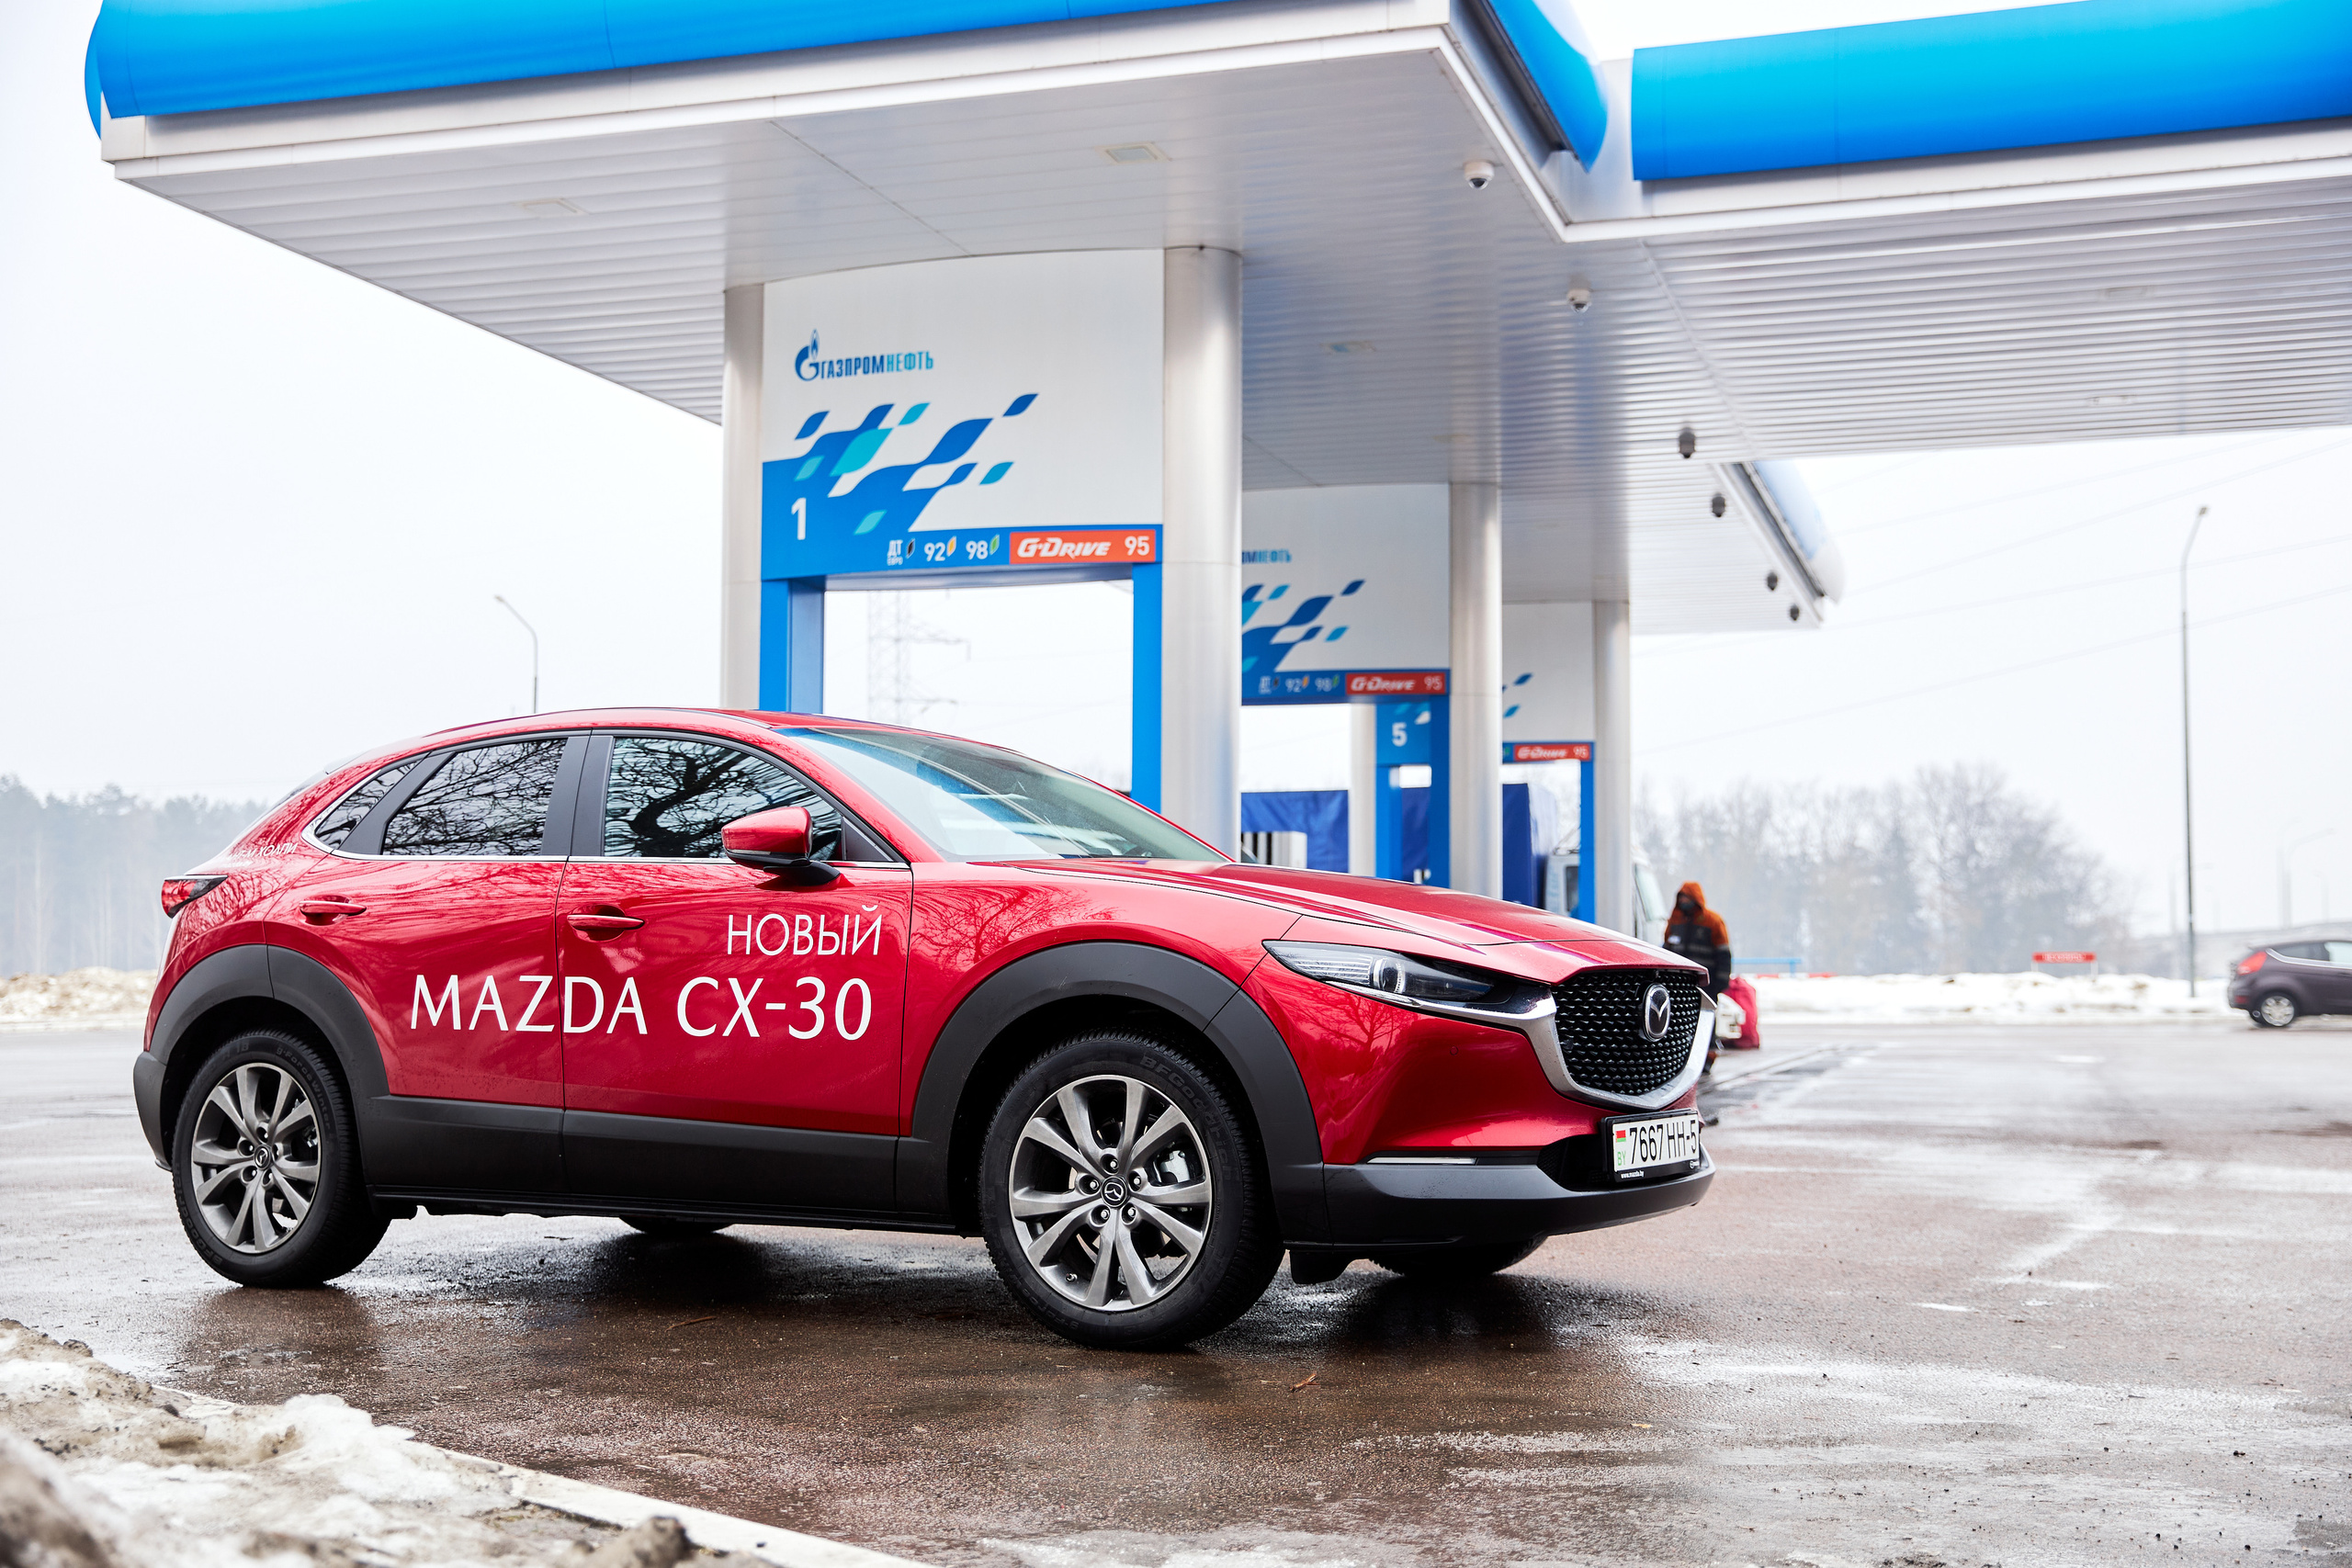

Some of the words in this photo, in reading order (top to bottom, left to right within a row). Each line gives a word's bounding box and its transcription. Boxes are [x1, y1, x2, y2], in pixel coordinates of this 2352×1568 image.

[820, 351, 934, 380] ГАЗПРОМНЕФТЬ
[791, 497, 807, 541] 1
[887, 539, 904, 557] ДТ
[924, 542, 946, 561] 92
[966, 540, 989, 560] 98
[1125, 535, 1151, 556] 95
[1285, 678, 1302, 693] 92
[1315, 677, 1333, 693] 98
[1424, 676, 1442, 691] 95
[1392, 722, 1408, 748] 5
[257, 842, 299, 857] ХОЛПИ
[727, 903, 883, 956] НОВЫЙ
[410, 974, 649, 1035] MAZDA
[676, 976, 873, 1041] CX-30
[1629, 1123, 1664, 1165] 7667
[1666, 1119, 1697, 1159] HH-5
[1617, 1151, 1626, 1167] BY
